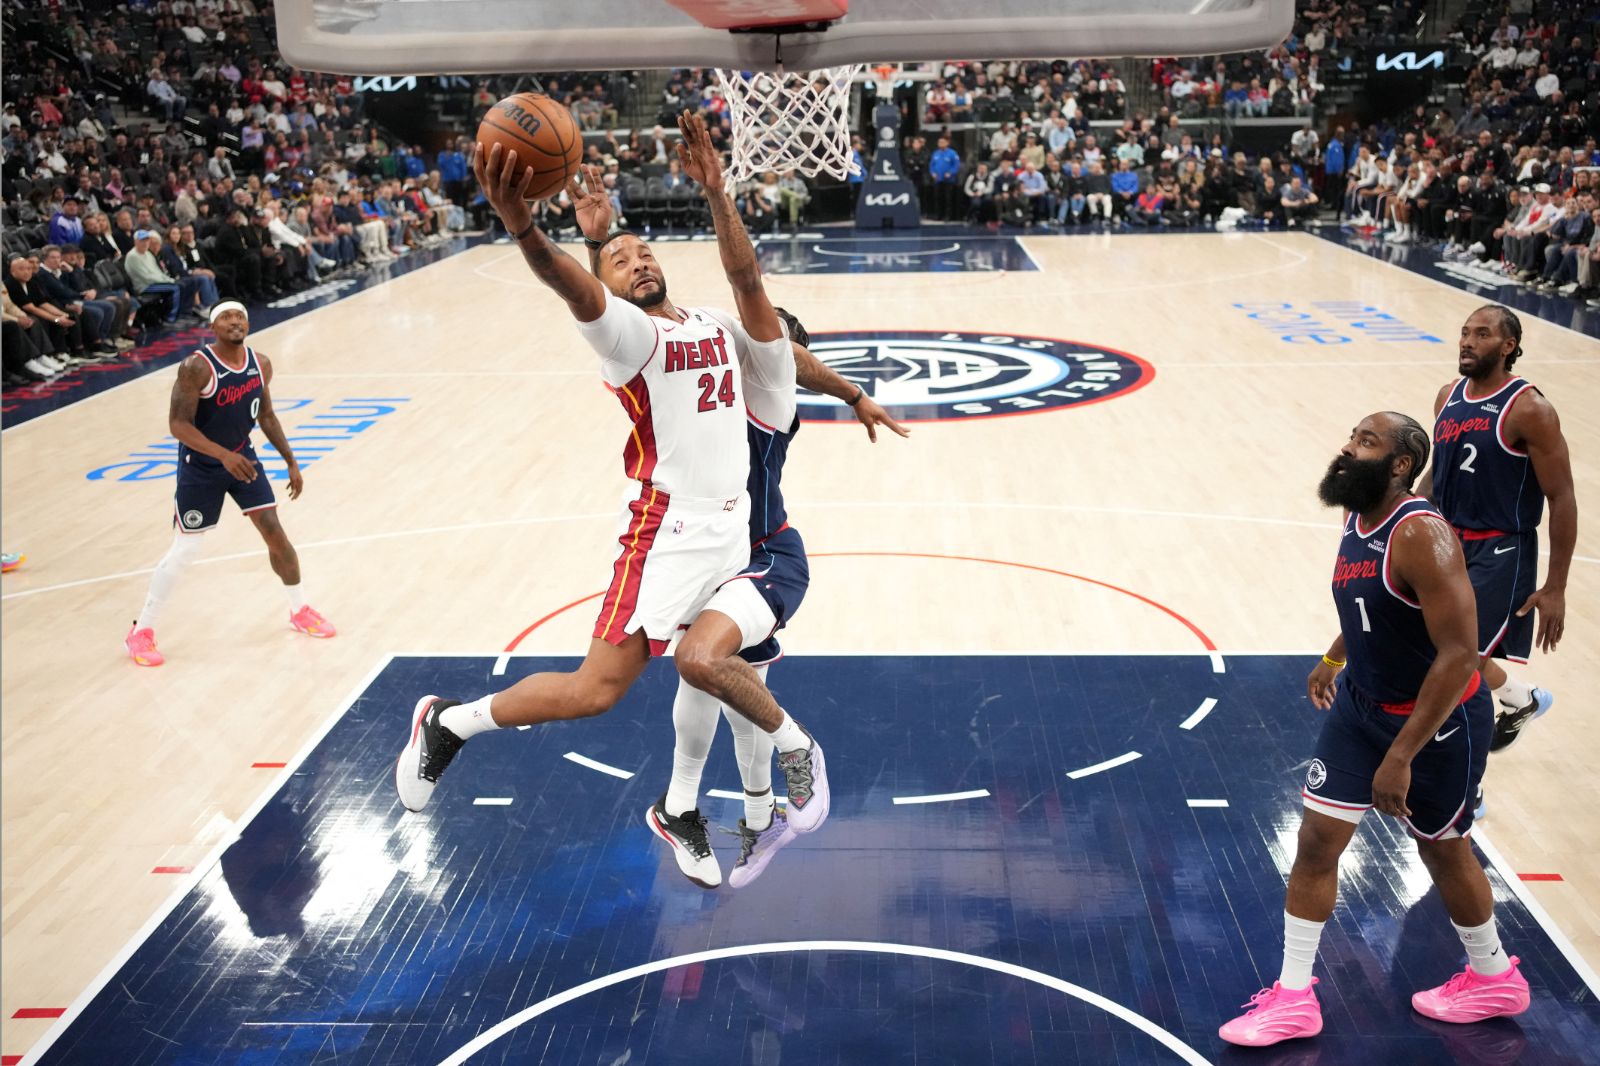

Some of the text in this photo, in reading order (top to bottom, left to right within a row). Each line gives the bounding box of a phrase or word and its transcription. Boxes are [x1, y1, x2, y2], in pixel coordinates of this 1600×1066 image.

[1376, 51, 1444, 71] KIA
[492, 101, 541, 137] Wil
[664, 327, 729, 373] HEAT
[940, 333, 1054, 349] LOS
[216, 376, 261, 407] Clippers
[697, 369, 735, 413] 24
[250, 397, 260, 419] 0
[1460, 443, 1477, 473] 2
[1355, 597, 1371, 632] 1
